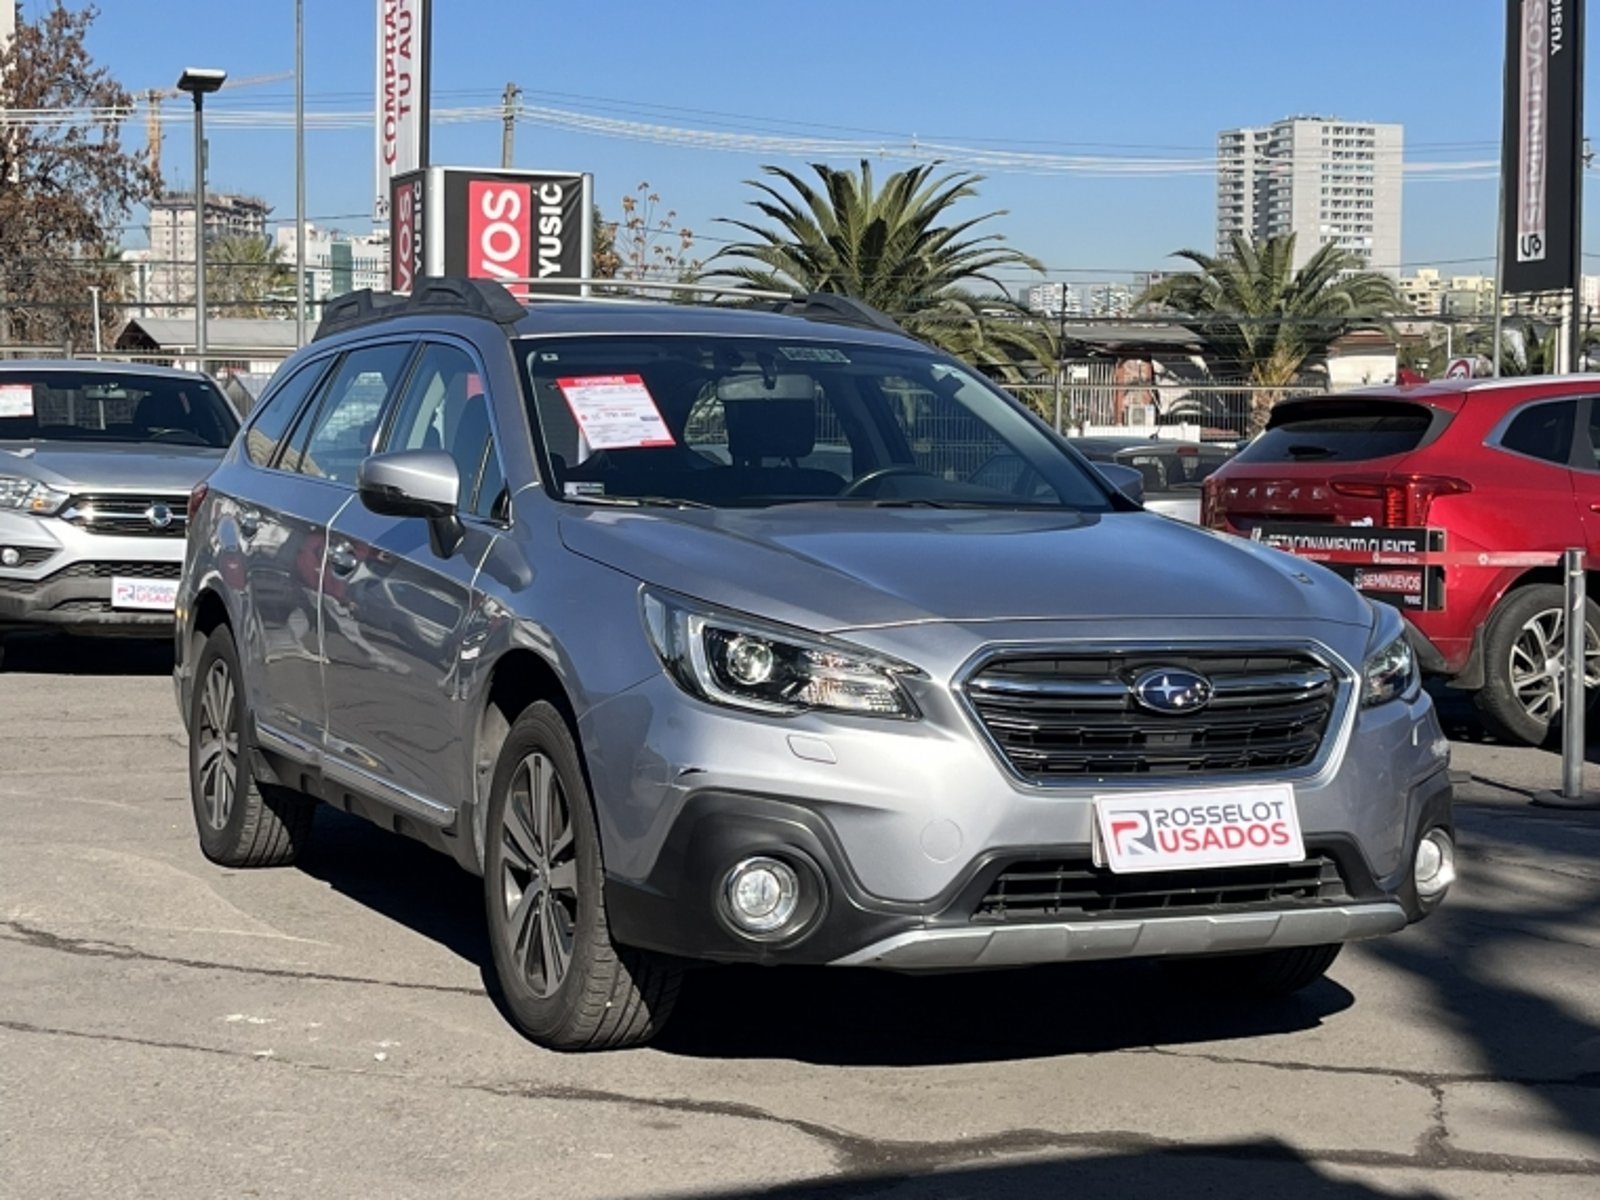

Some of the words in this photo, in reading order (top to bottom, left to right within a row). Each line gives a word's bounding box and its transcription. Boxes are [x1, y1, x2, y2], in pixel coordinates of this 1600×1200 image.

[383, 0, 396, 165] COMPRA
[399, 72, 411, 121] TU
[532, 183, 563, 278] YUSIĆ
[1368, 538, 1416, 552] CLIENTE
[1362, 573, 1421, 591] SEMINUEVOS
[1154, 801, 1284, 828] ROSSELOT
[1158, 822, 1291, 853] USADOS
